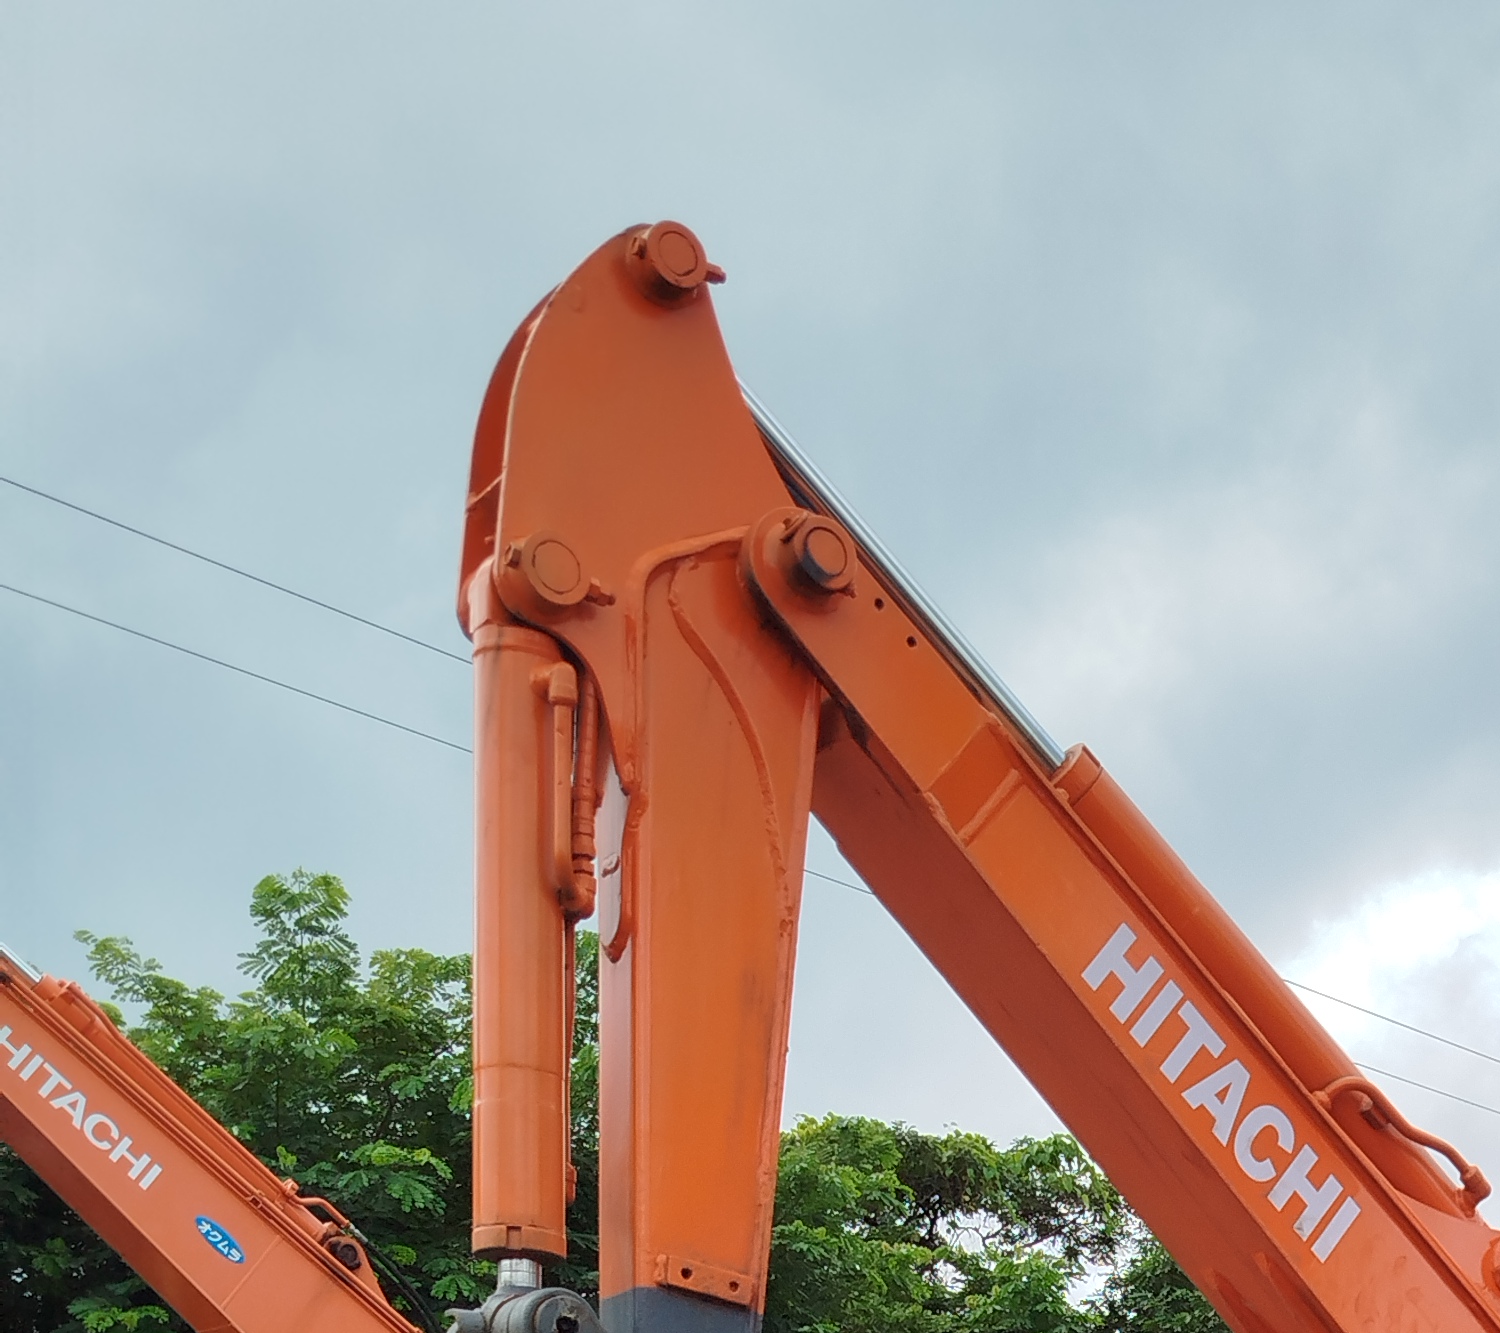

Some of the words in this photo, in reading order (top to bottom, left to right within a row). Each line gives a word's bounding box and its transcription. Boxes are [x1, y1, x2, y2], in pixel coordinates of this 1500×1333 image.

[0, 1025, 163, 1191] HITACHI
[1080, 922, 1362, 1264] HITACHI
[197, 1219, 242, 1262] オクムラ
